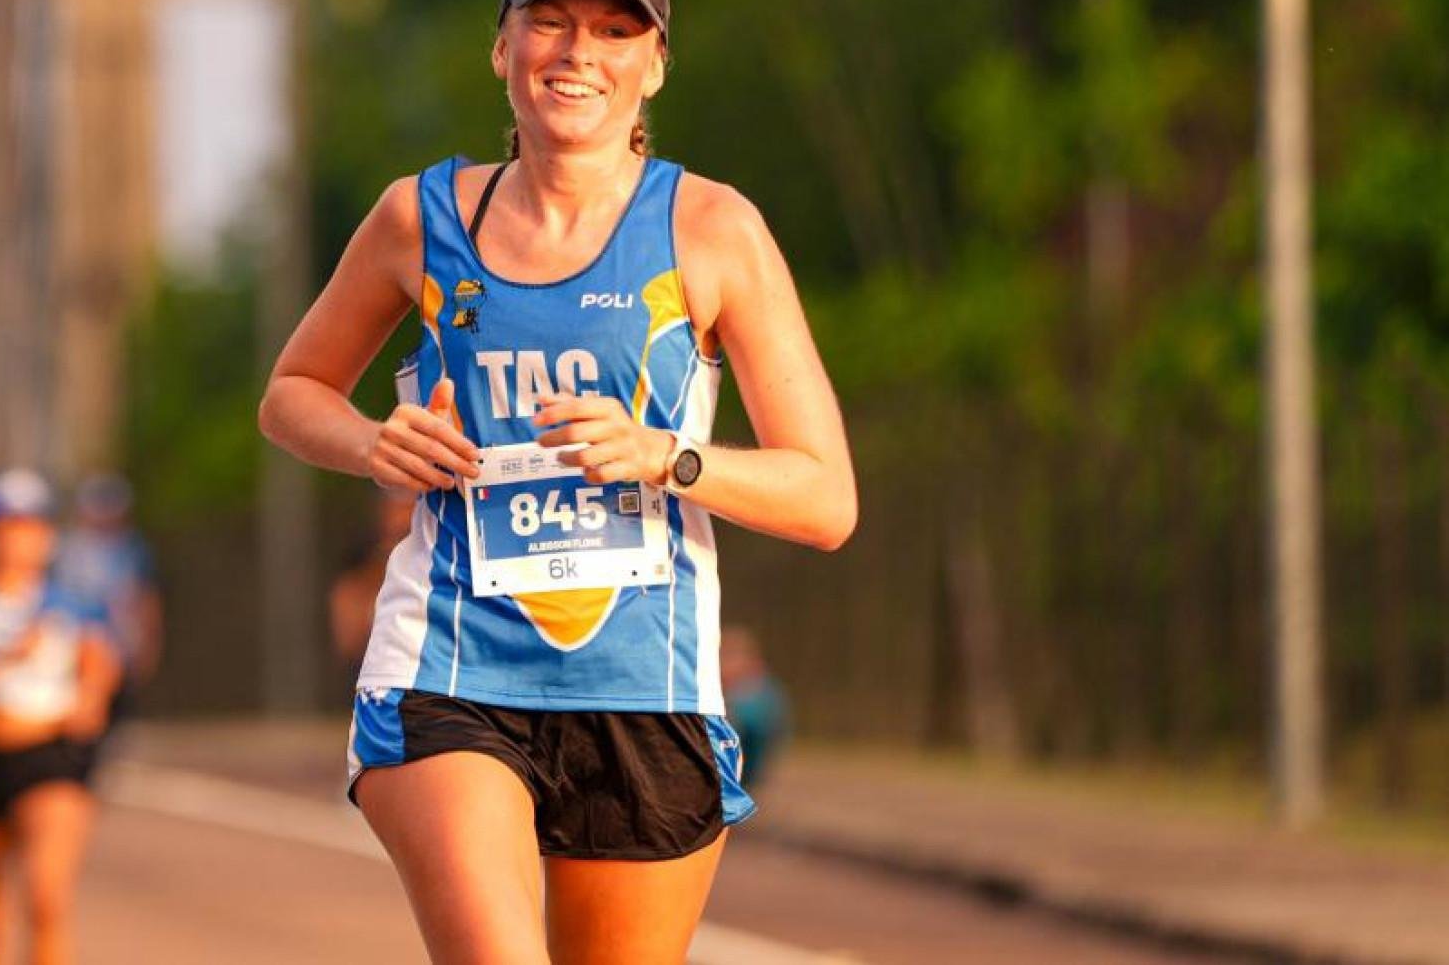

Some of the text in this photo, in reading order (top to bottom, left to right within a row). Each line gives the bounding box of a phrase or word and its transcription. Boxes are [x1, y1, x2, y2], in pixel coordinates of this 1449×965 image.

[580, 293, 634, 309] POLI
[476, 349, 600, 419] TAC
[509, 487, 607, 536] 845
[549, 557, 579, 580] 6k
